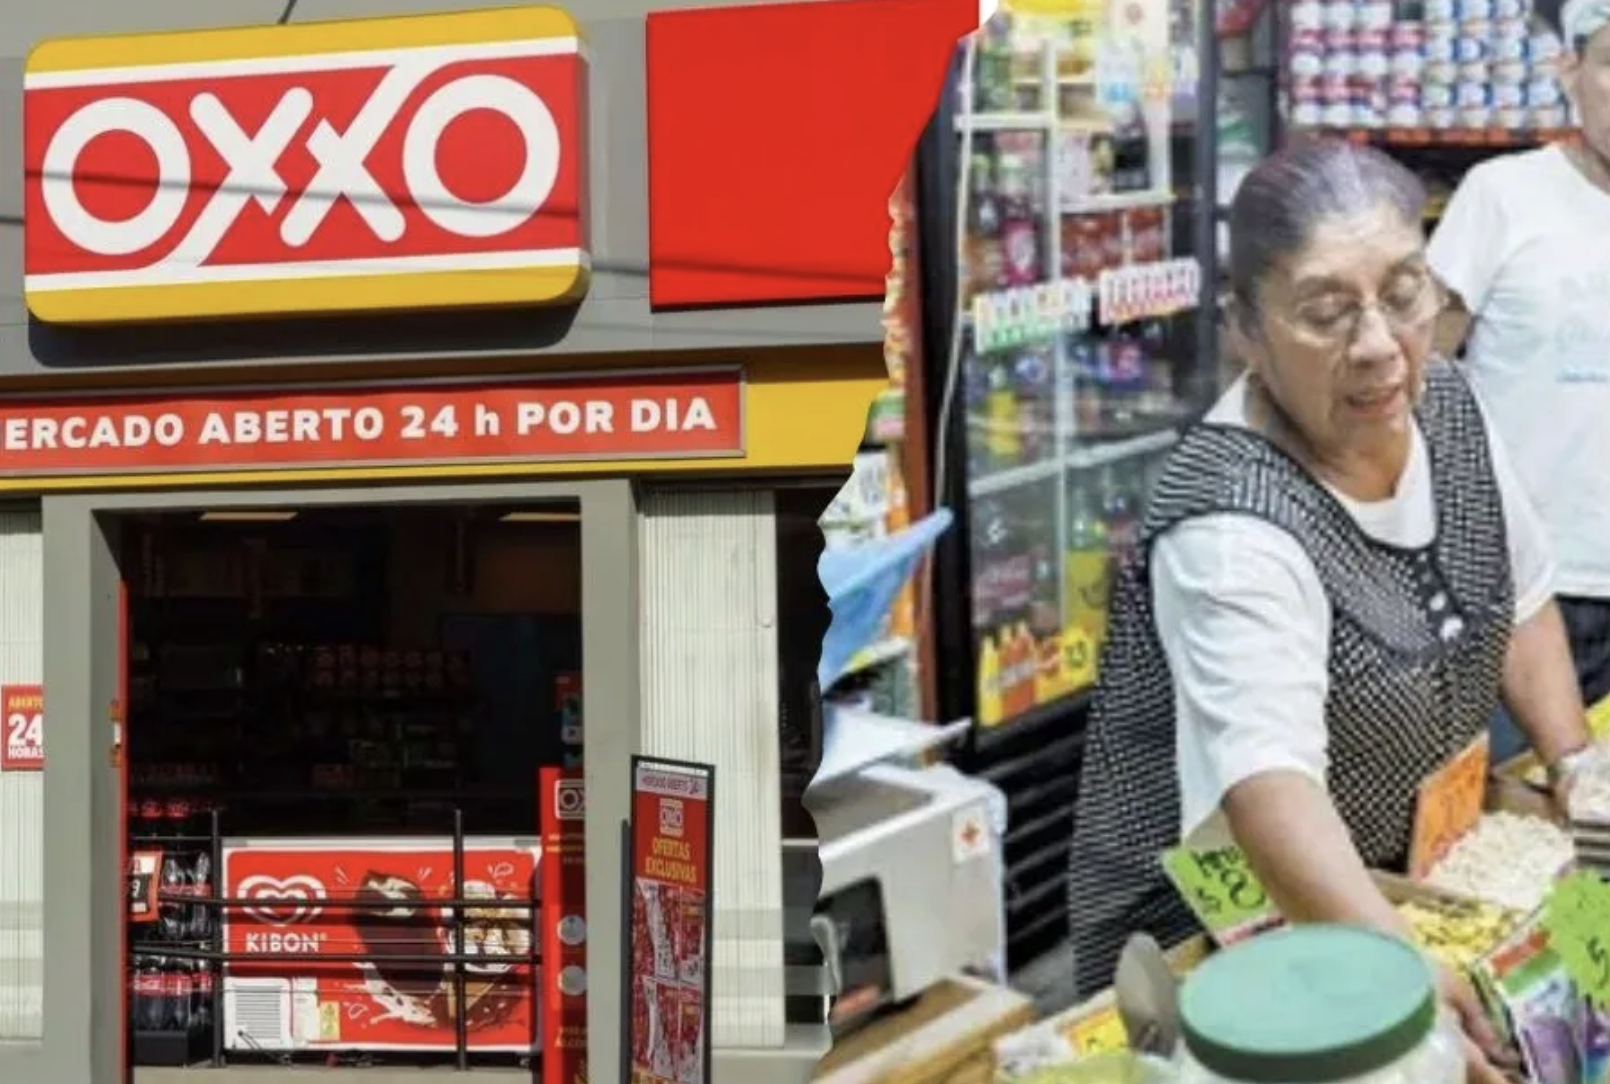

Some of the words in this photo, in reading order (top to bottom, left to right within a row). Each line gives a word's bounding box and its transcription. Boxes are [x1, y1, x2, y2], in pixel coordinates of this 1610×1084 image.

[42, 74, 560, 258] OXXO
[0, 413, 184, 450] ERCADO
[198, 406, 384, 445] ABERTO
[400, 404, 458, 439] 24
[475, 403, 499, 436] h
[517, 400, 614, 436] POR
[630, 397, 717, 433] DIA
[8, 713, 43, 746] 24
